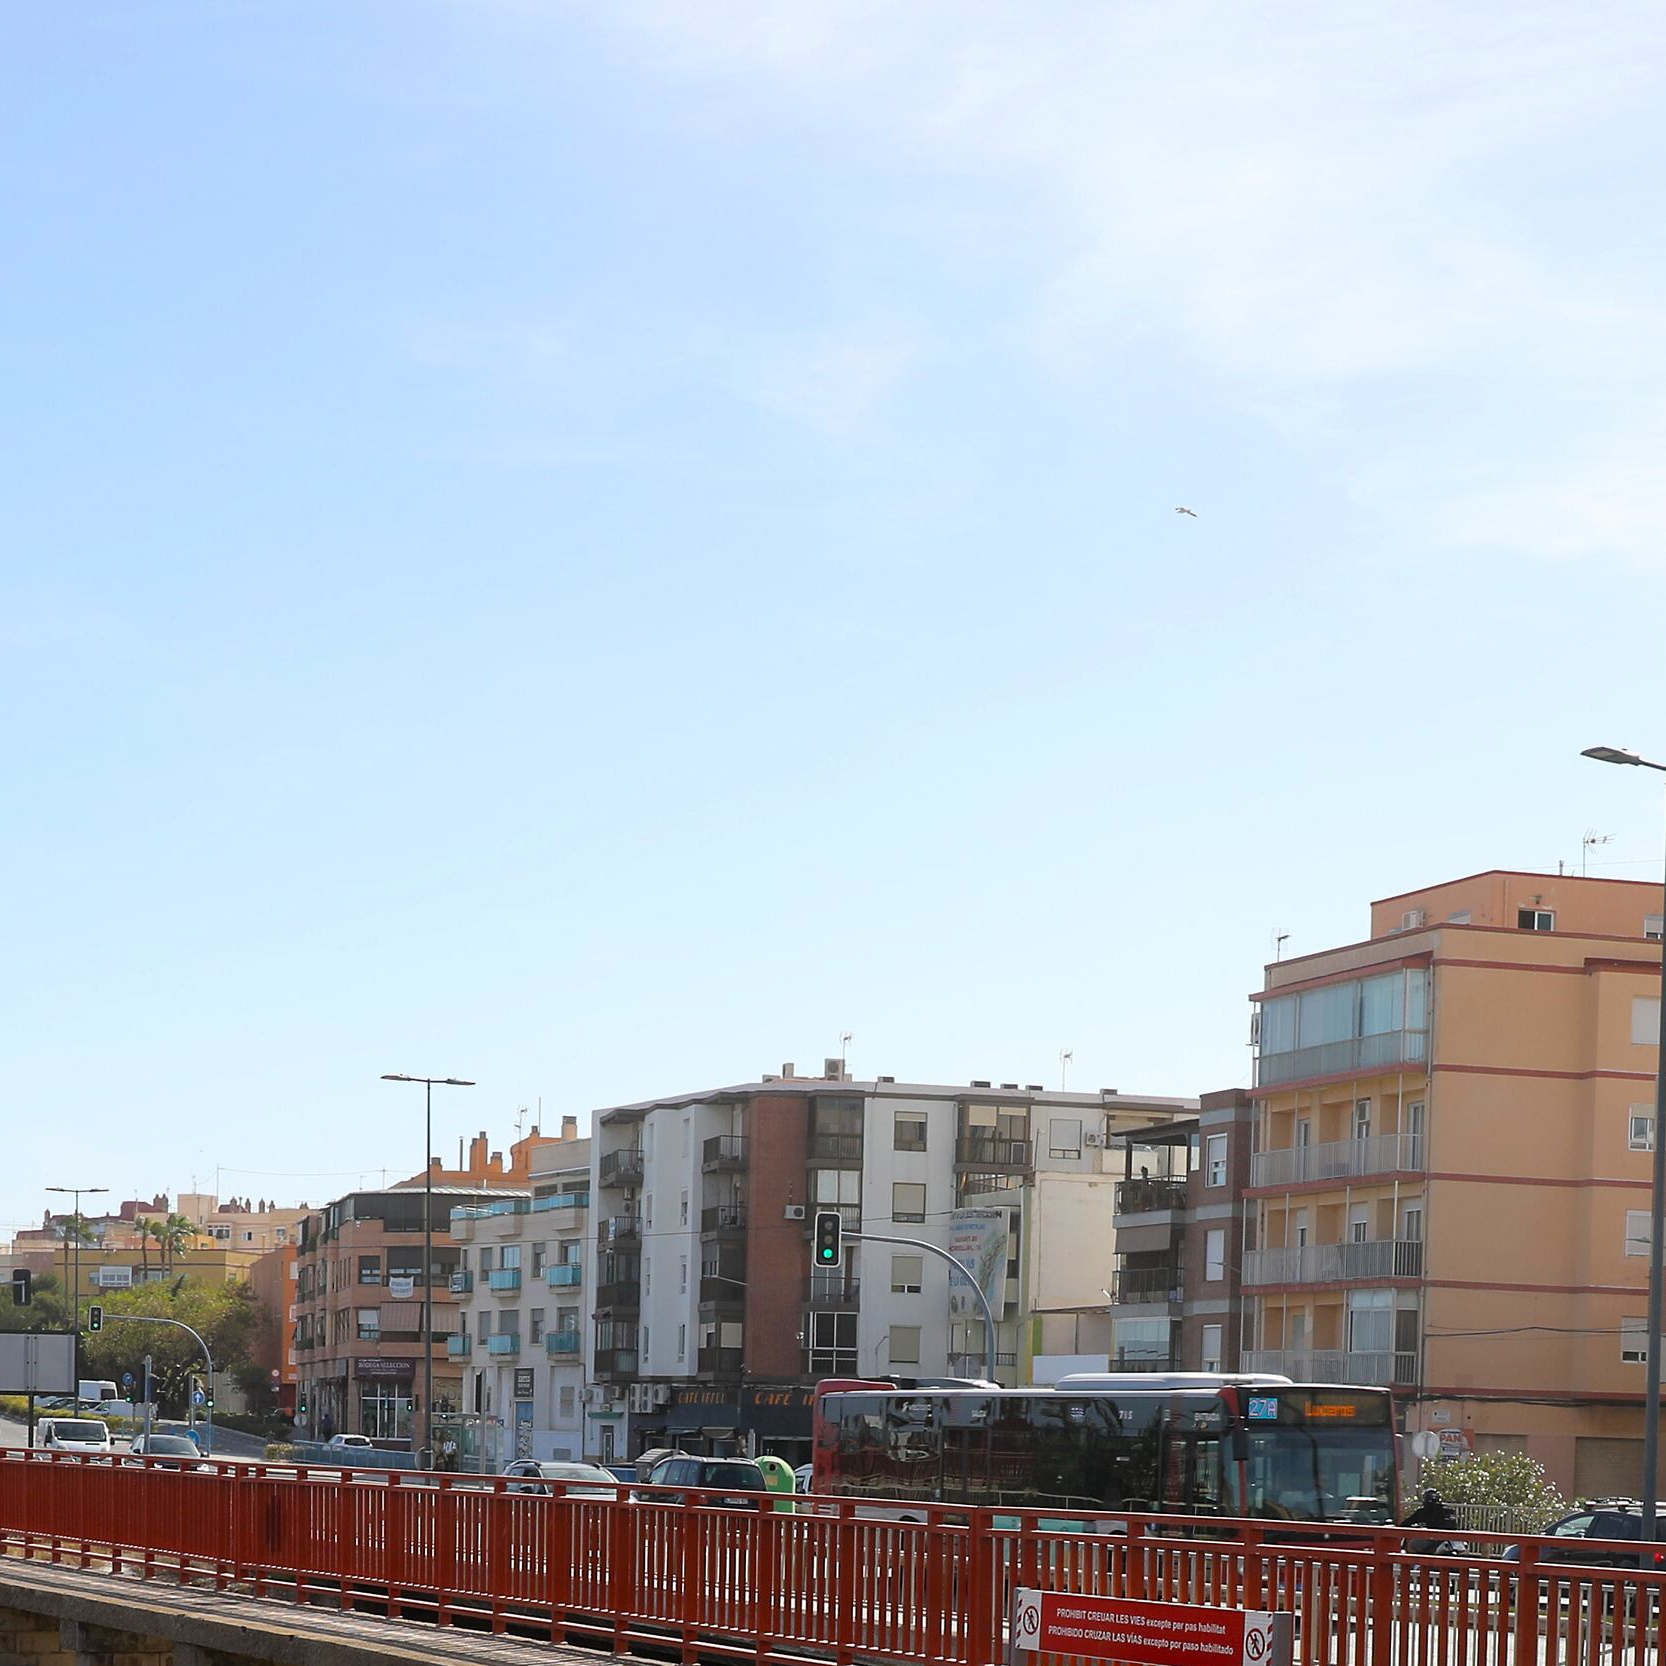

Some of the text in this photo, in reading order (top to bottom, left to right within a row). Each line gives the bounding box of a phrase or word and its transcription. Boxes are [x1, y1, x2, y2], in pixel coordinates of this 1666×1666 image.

[1249, 1399, 1277, 1417] 27A
[1440, 1434, 1461, 1442] PAN
[1056, 1608, 1087, 1620] PROHIBIT
[1087, 1611, 1115, 1623] CREUAR
[1115, 1614, 1129, 1624] LES
[1130, 1615, 1146, 1626] VIES
[1172, 1622, 1183, 1631] per
[1184, 1623, 1197, 1632] pas
[1198, 1622, 1226, 1635] habilitat
[1048, 1625, 1083, 1638] PROHIBIDO
[1084, 1629, 1111, 1641] CRUZAR
[1112, 1632, 1126, 1643] LAS
[1143, 1638, 1169, 1648] excepto
[1169, 1641, 1182, 1650] por
[1182, 1642, 1200, 1652] paso
[1200, 1642, 1234, 1655] habilitado
